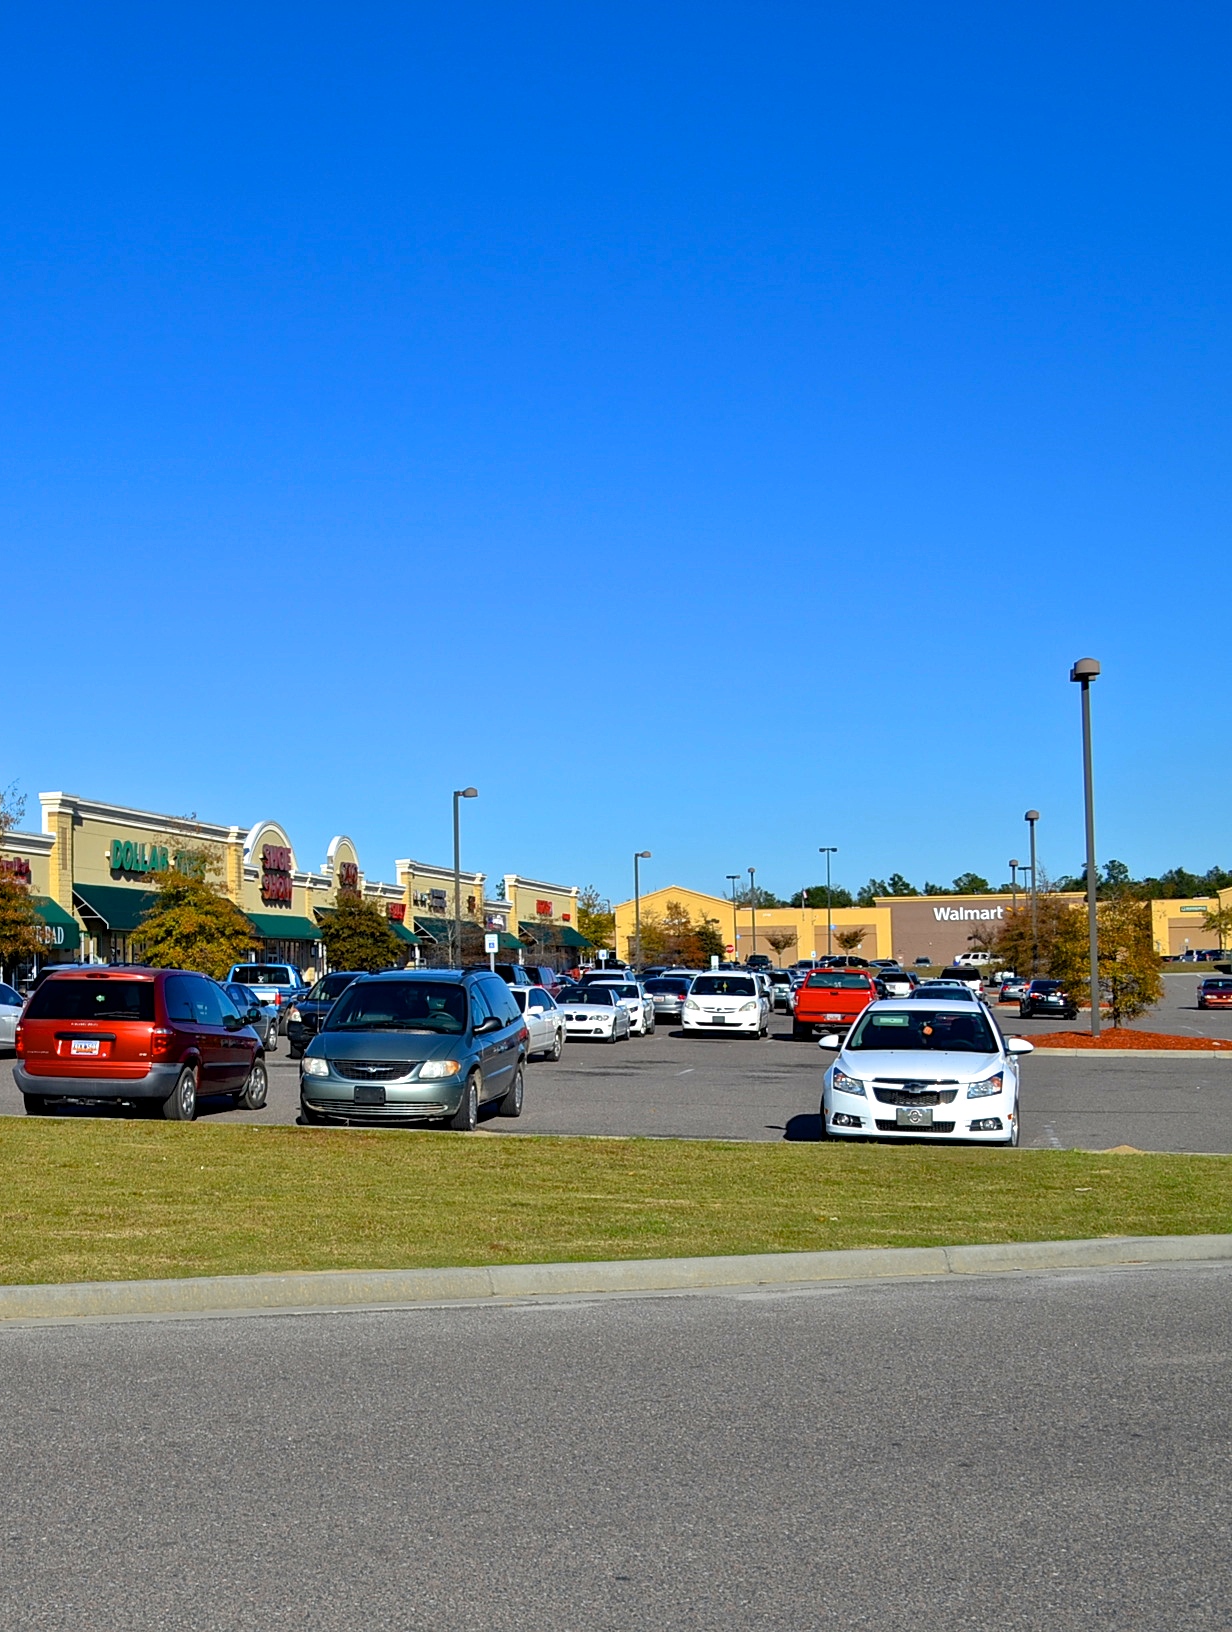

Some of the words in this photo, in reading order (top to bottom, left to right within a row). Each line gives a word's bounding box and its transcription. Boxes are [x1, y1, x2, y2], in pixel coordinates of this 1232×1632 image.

[110, 839, 170, 873] DOLLAR
[263, 843, 292, 872] SHOE
[933, 905, 1004, 921] Walmart
